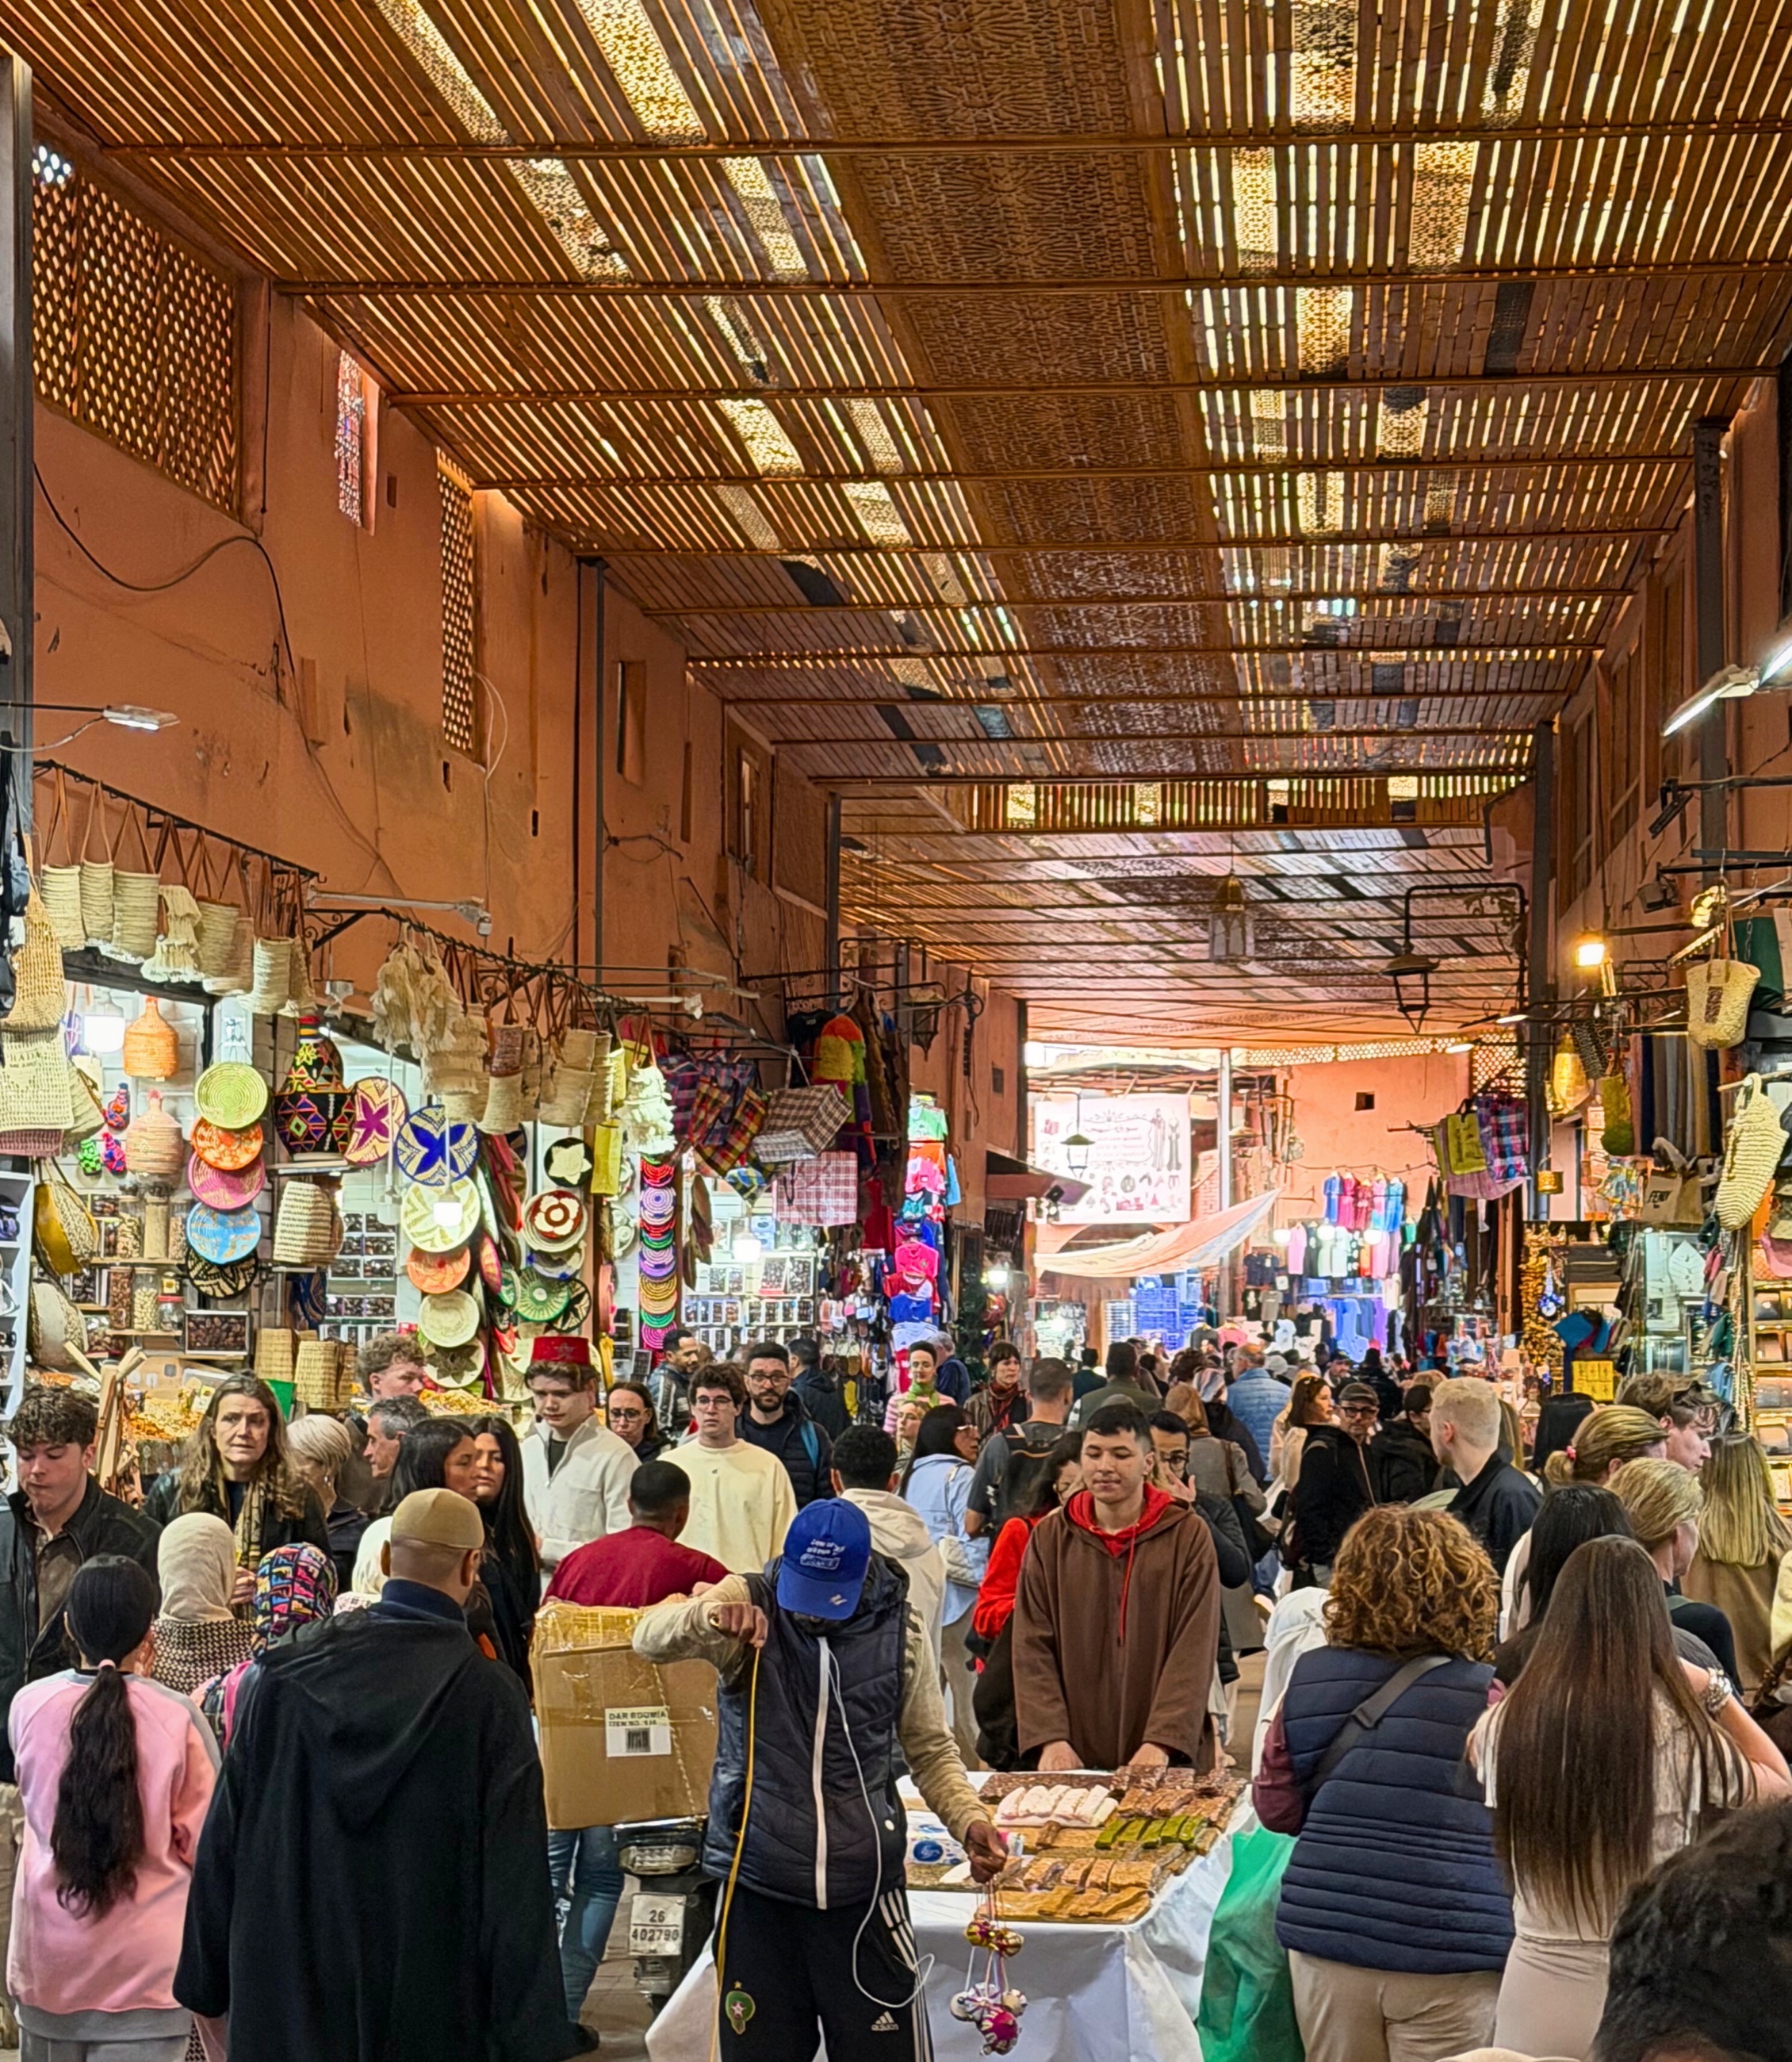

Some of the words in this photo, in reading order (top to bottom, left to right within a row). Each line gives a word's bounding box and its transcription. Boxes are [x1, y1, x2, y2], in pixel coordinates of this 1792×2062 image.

[649, 1910, 665, 1923] 26
[631, 1928, 680, 1941] 402790
[871, 2023, 899, 2032] adidas
